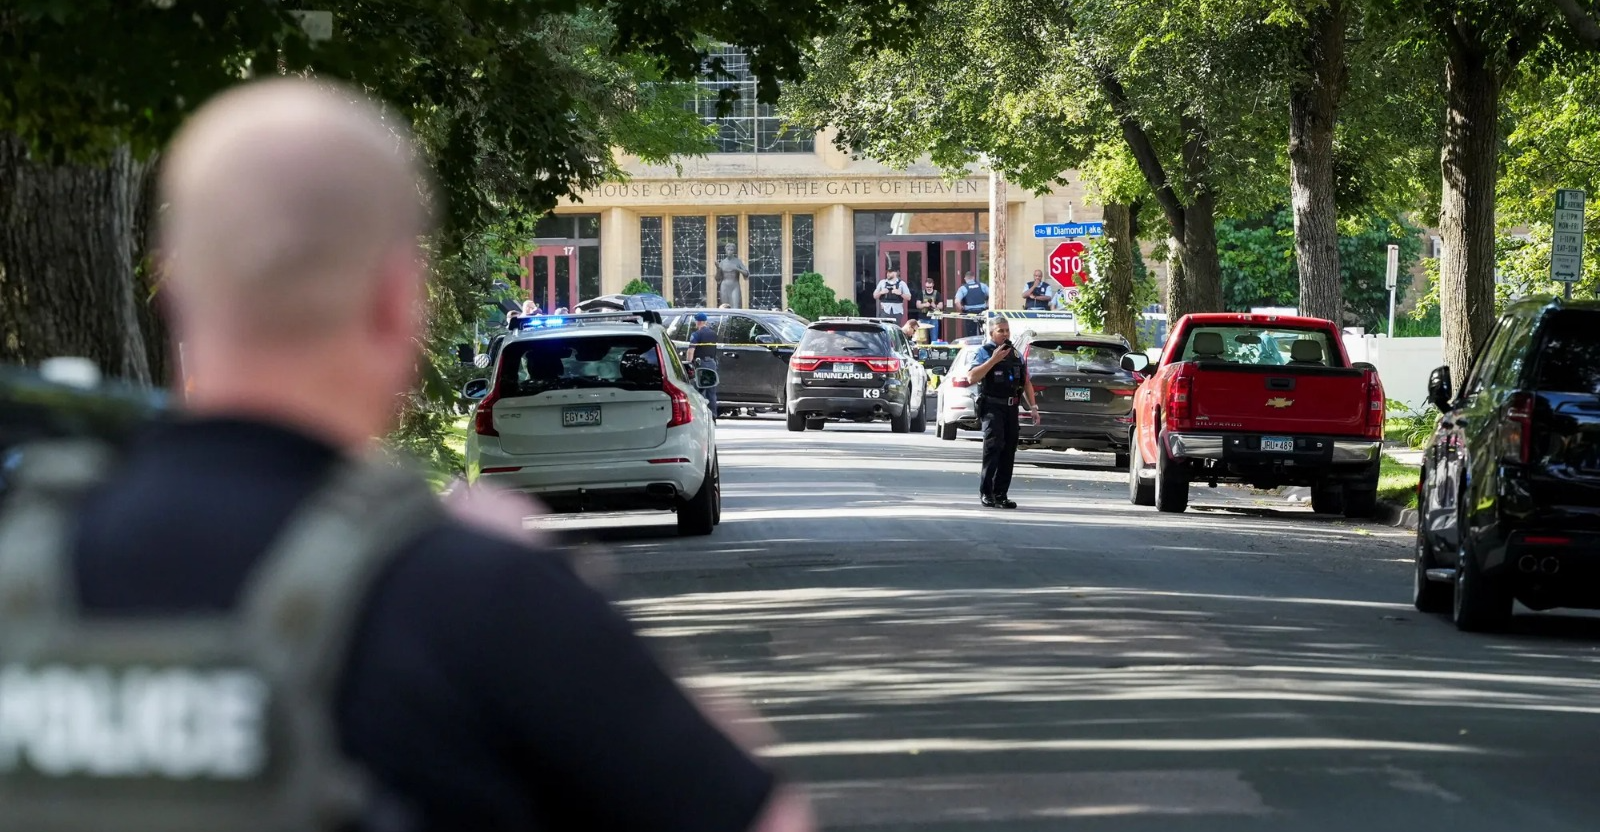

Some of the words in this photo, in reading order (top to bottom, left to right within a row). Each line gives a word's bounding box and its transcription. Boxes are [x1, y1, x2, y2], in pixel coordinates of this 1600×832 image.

[591, 183, 650, 198] HOUSE
[660, 184, 683, 197] OF
[690, 183, 730, 197] GOD
[737, 182, 776, 196] AND
[786, 182, 818, 196] THE
[826, 182, 871, 195] GATE
[879, 181, 901, 195] OF
[910, 181, 978, 194] HEAVEN
[1046, 227, 1052, 236] W
[1053, 226, 1084, 235] Diamond
[1084, 225, 1101, 235] Lake
[1558, 222, 1579, 230] MON-FRI
[563, 246, 575, 256] 17
[966, 241, 975, 251] 16
[1556, 245, 1578, 253] SAT-SUN
[1051, 256, 1082, 275] STO
[813, 372, 873, 380] MINNEAPOLIS
[863, 388, 881, 399] K9
